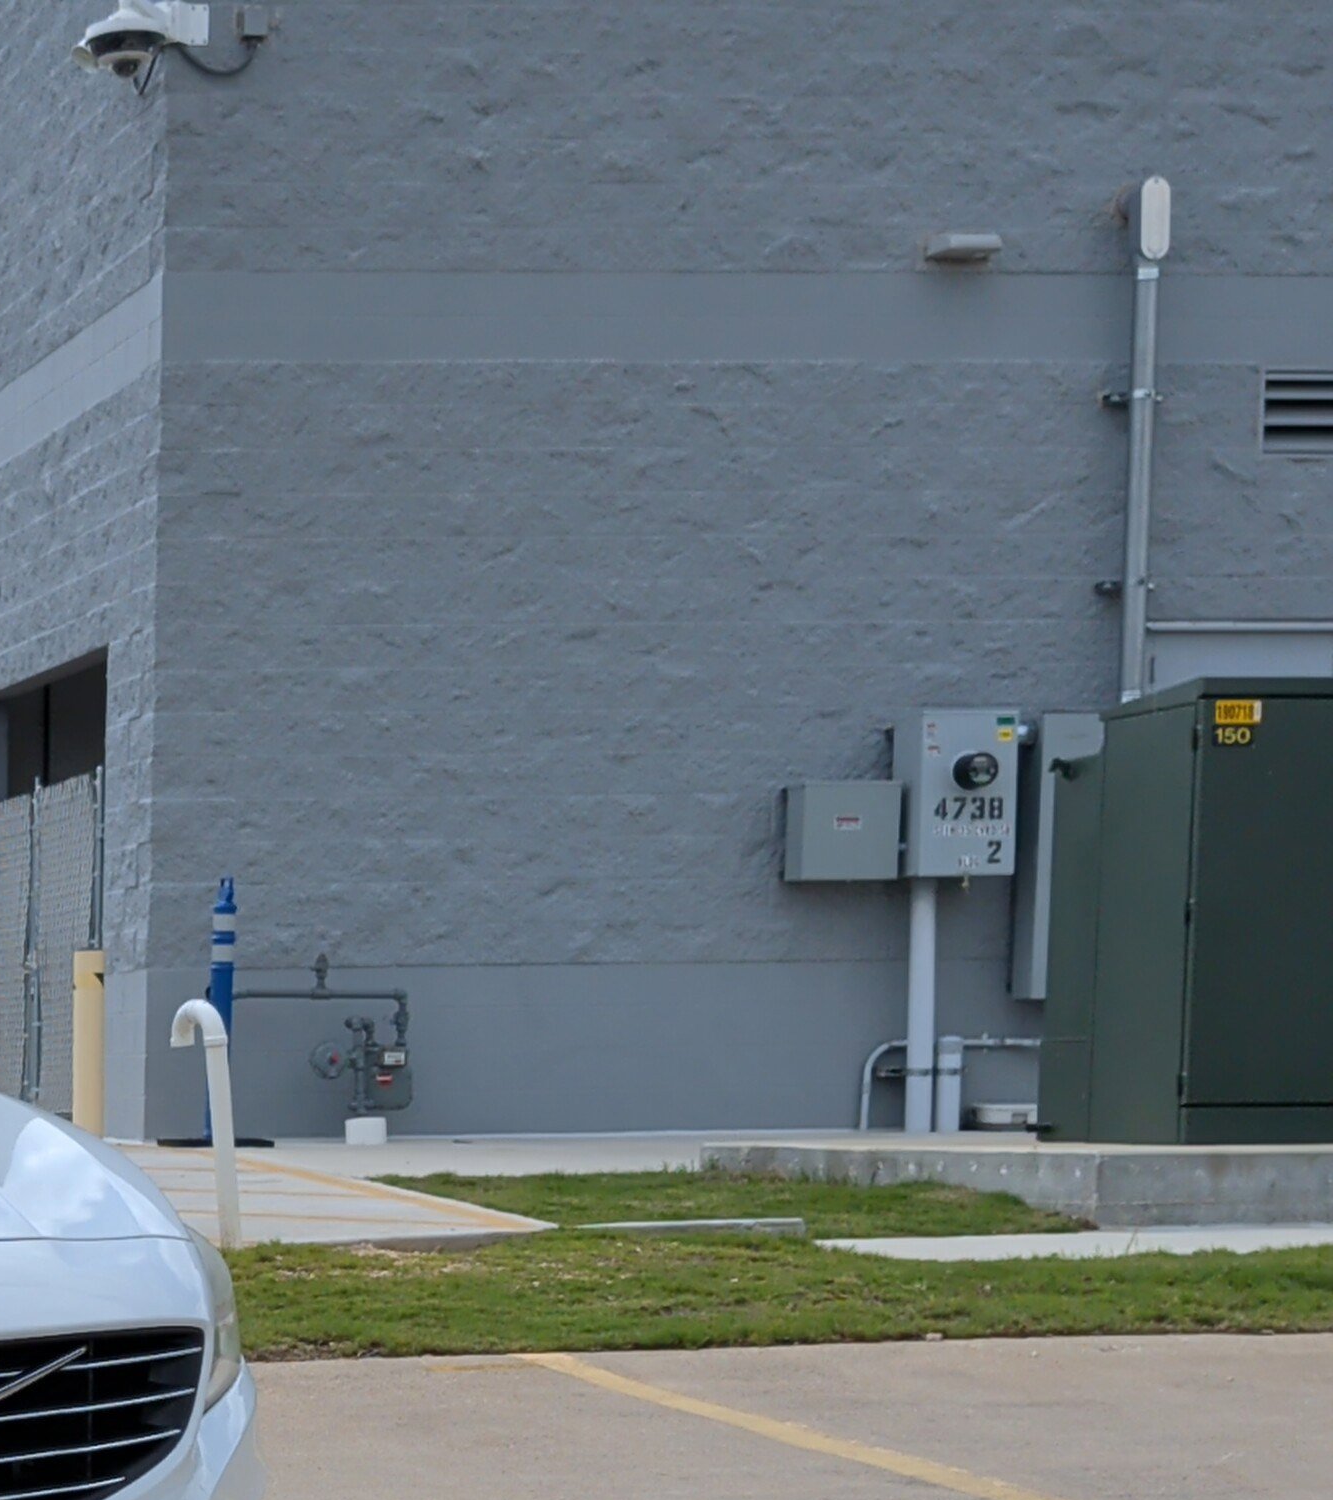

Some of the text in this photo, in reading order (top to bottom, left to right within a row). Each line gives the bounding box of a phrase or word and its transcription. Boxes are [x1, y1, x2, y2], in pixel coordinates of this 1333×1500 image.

[1215, 727, 1251, 745] 150
[934, 797, 1004, 820] 4738
[987, 840, 1002, 864] 2
